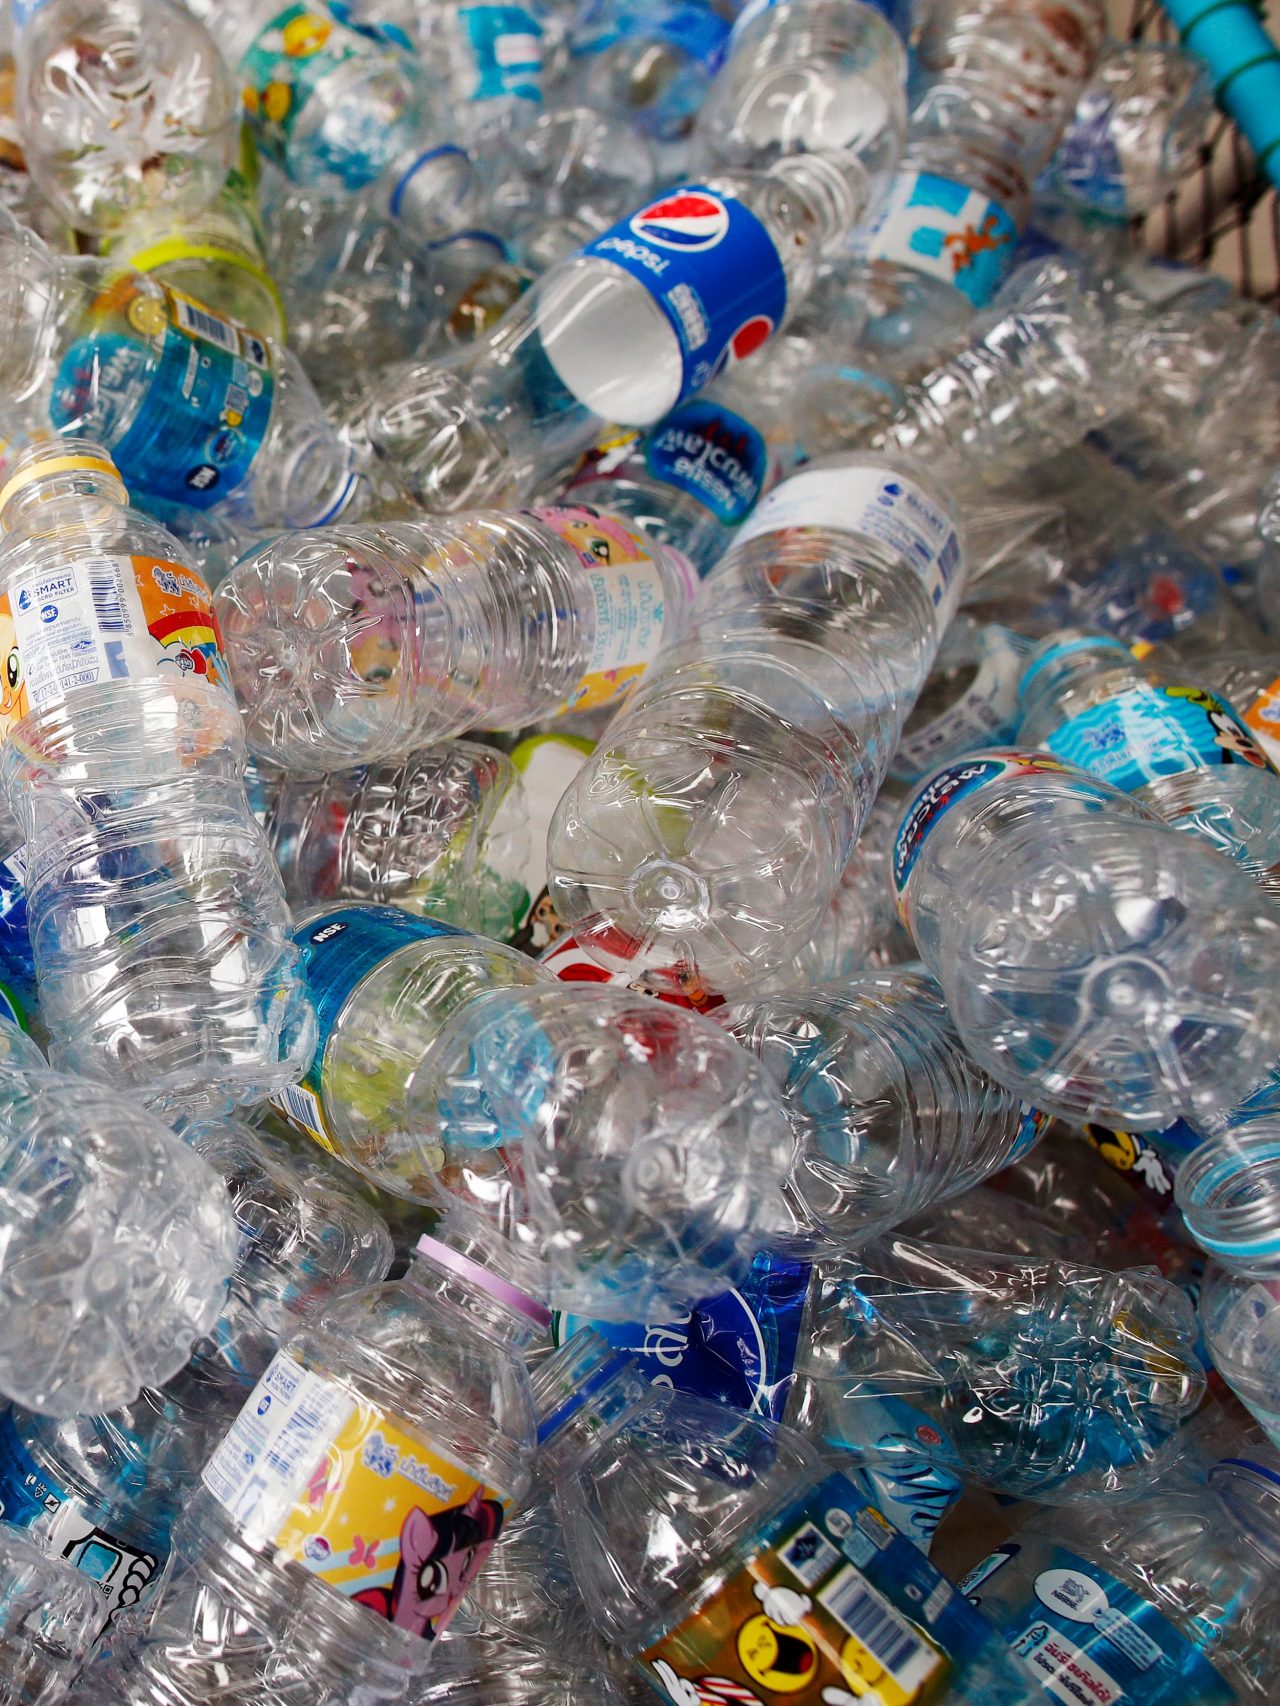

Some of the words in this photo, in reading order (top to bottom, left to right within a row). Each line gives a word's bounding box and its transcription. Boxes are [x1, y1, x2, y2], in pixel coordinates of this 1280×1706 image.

[599, 237, 668, 276] pepsi
[34, 578, 72, 597] SMART
[312, 922, 347, 943] NSF
